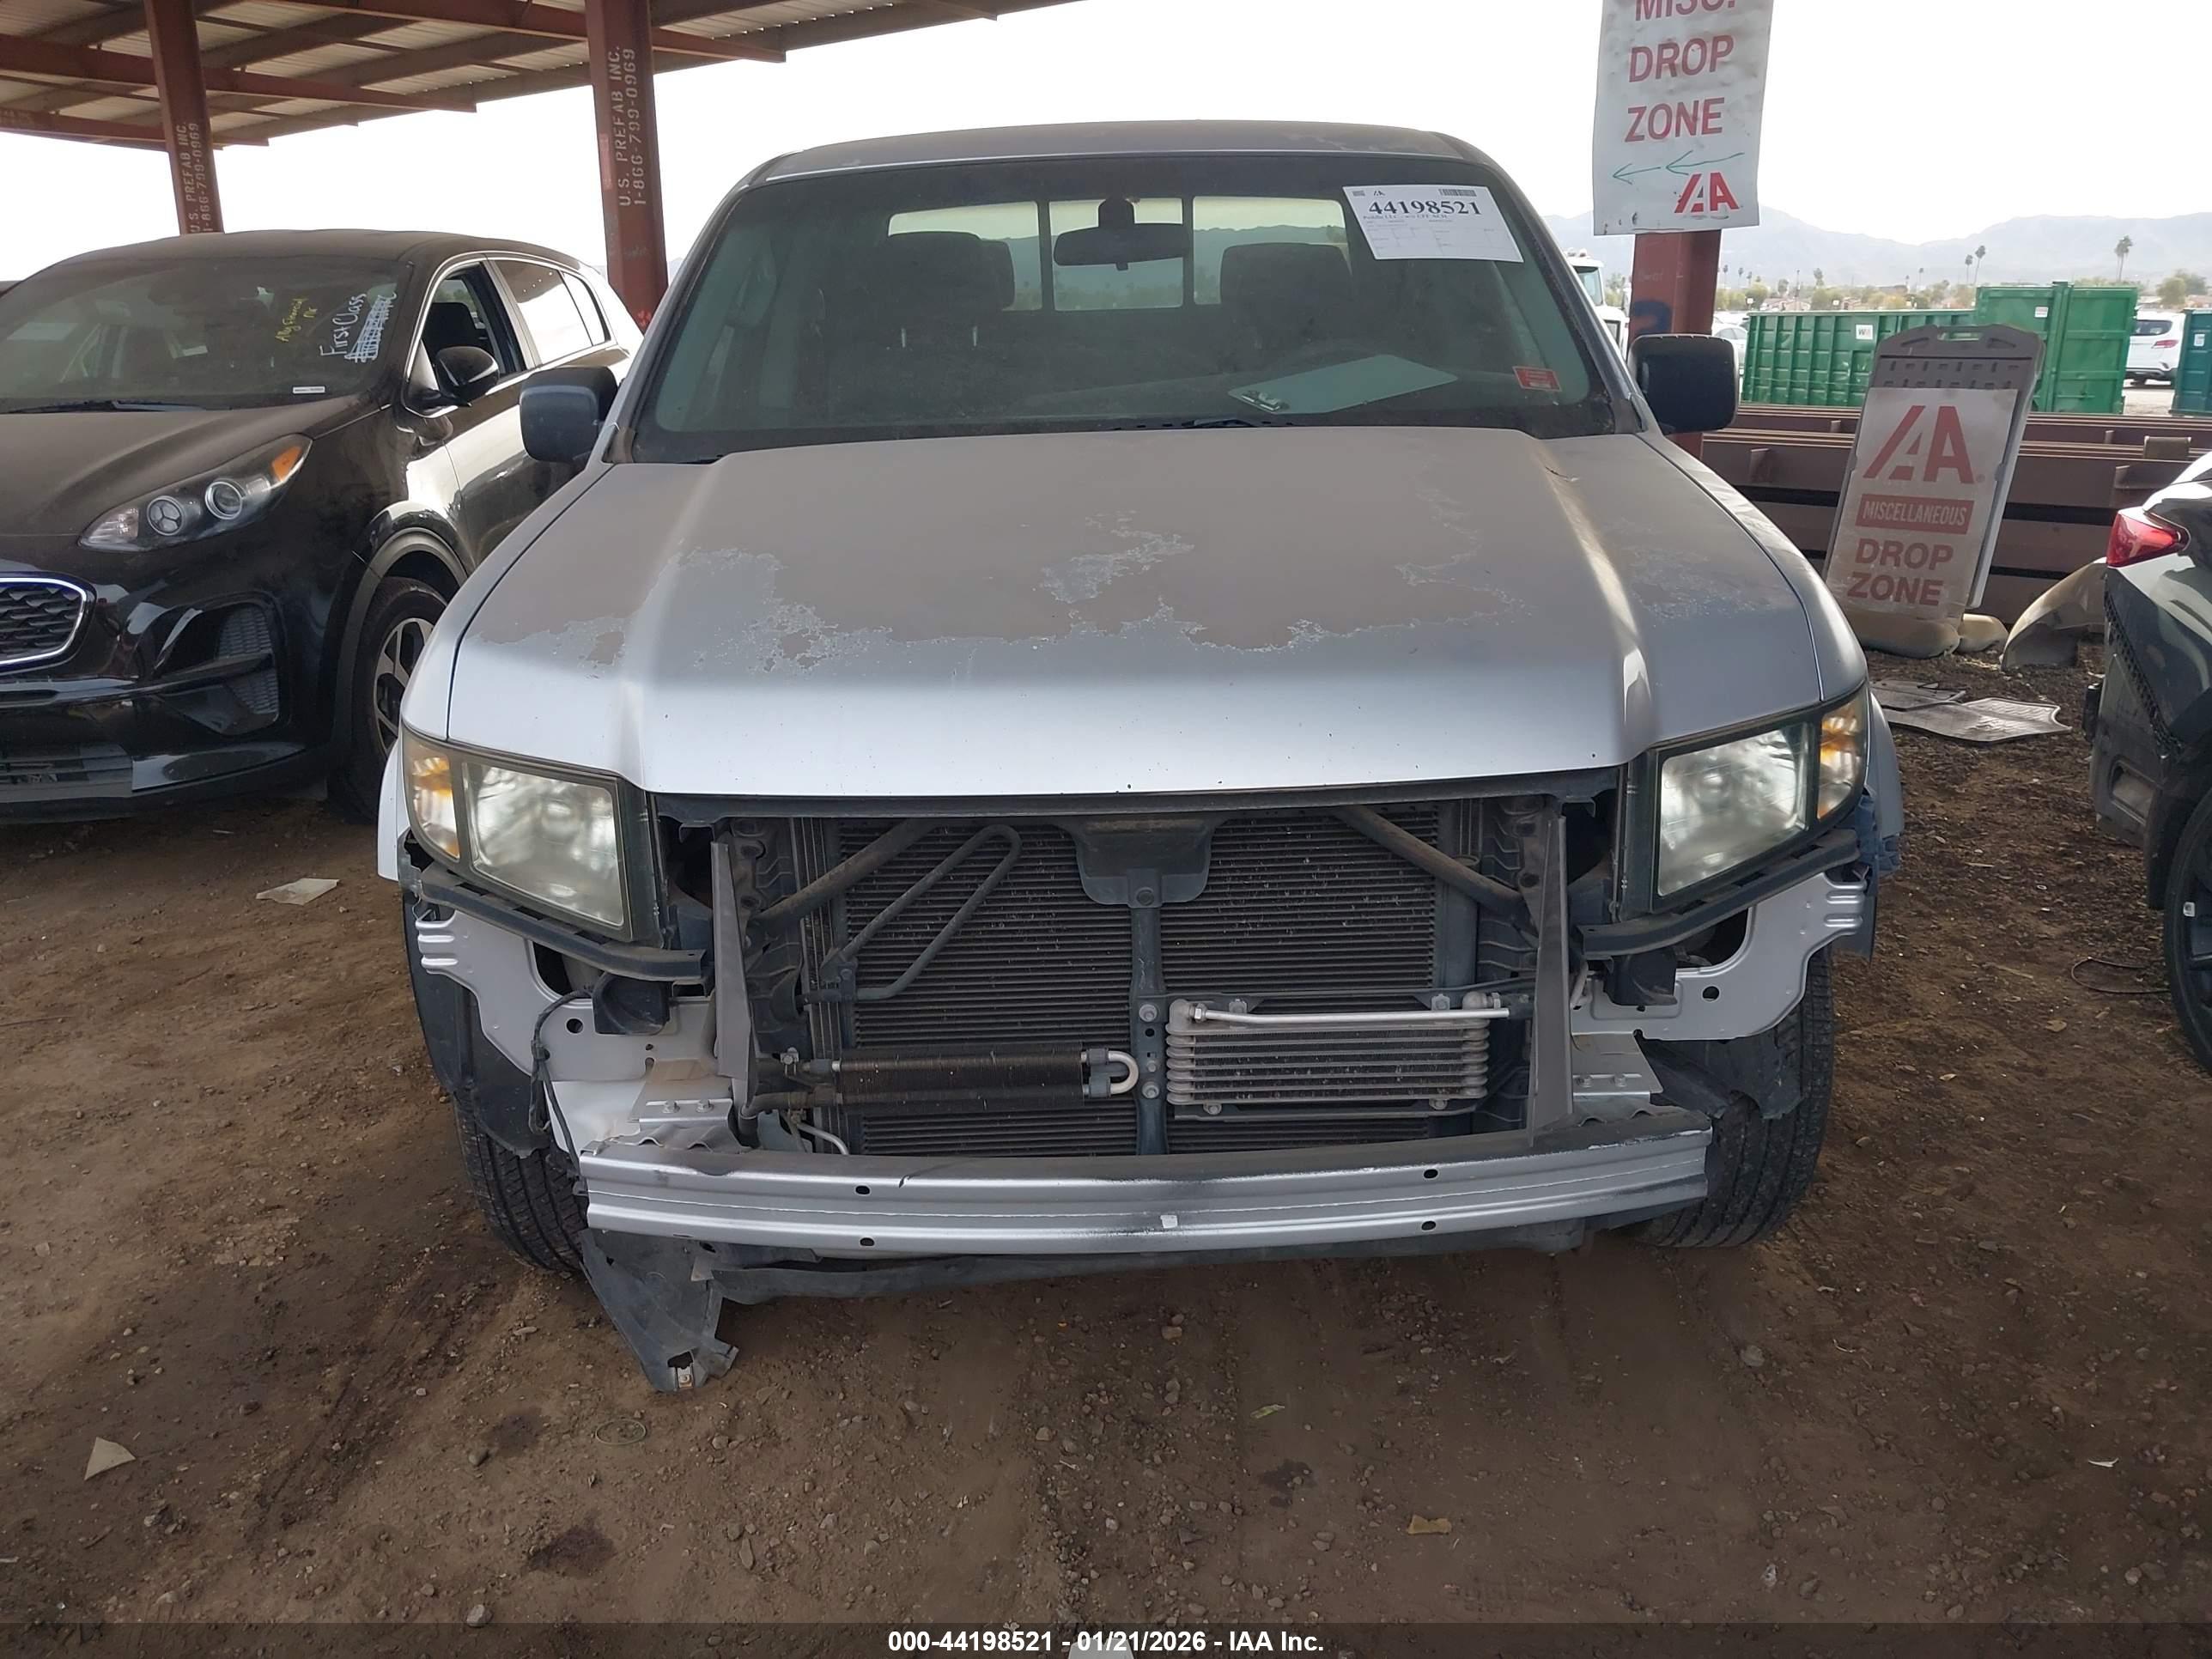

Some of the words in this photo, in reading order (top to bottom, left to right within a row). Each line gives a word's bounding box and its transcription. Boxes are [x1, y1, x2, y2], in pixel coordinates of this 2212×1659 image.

[608, 46, 623, 81] INC.
[1629, 35, 1735, 82] DROP
[611, 90, 629, 161] PREFAB
[1625, 97, 1725, 142] ZONE
[179, 151, 197, 203] PREFAB
[618, 173, 632, 206] U.S.
[1369, 199, 1482, 216] 44198521
[1863, 500, 1968, 527] MISCELLANEOUS
[1854, 538, 1954, 571] DROP
[1847, 572, 1944, 606] ZONE
